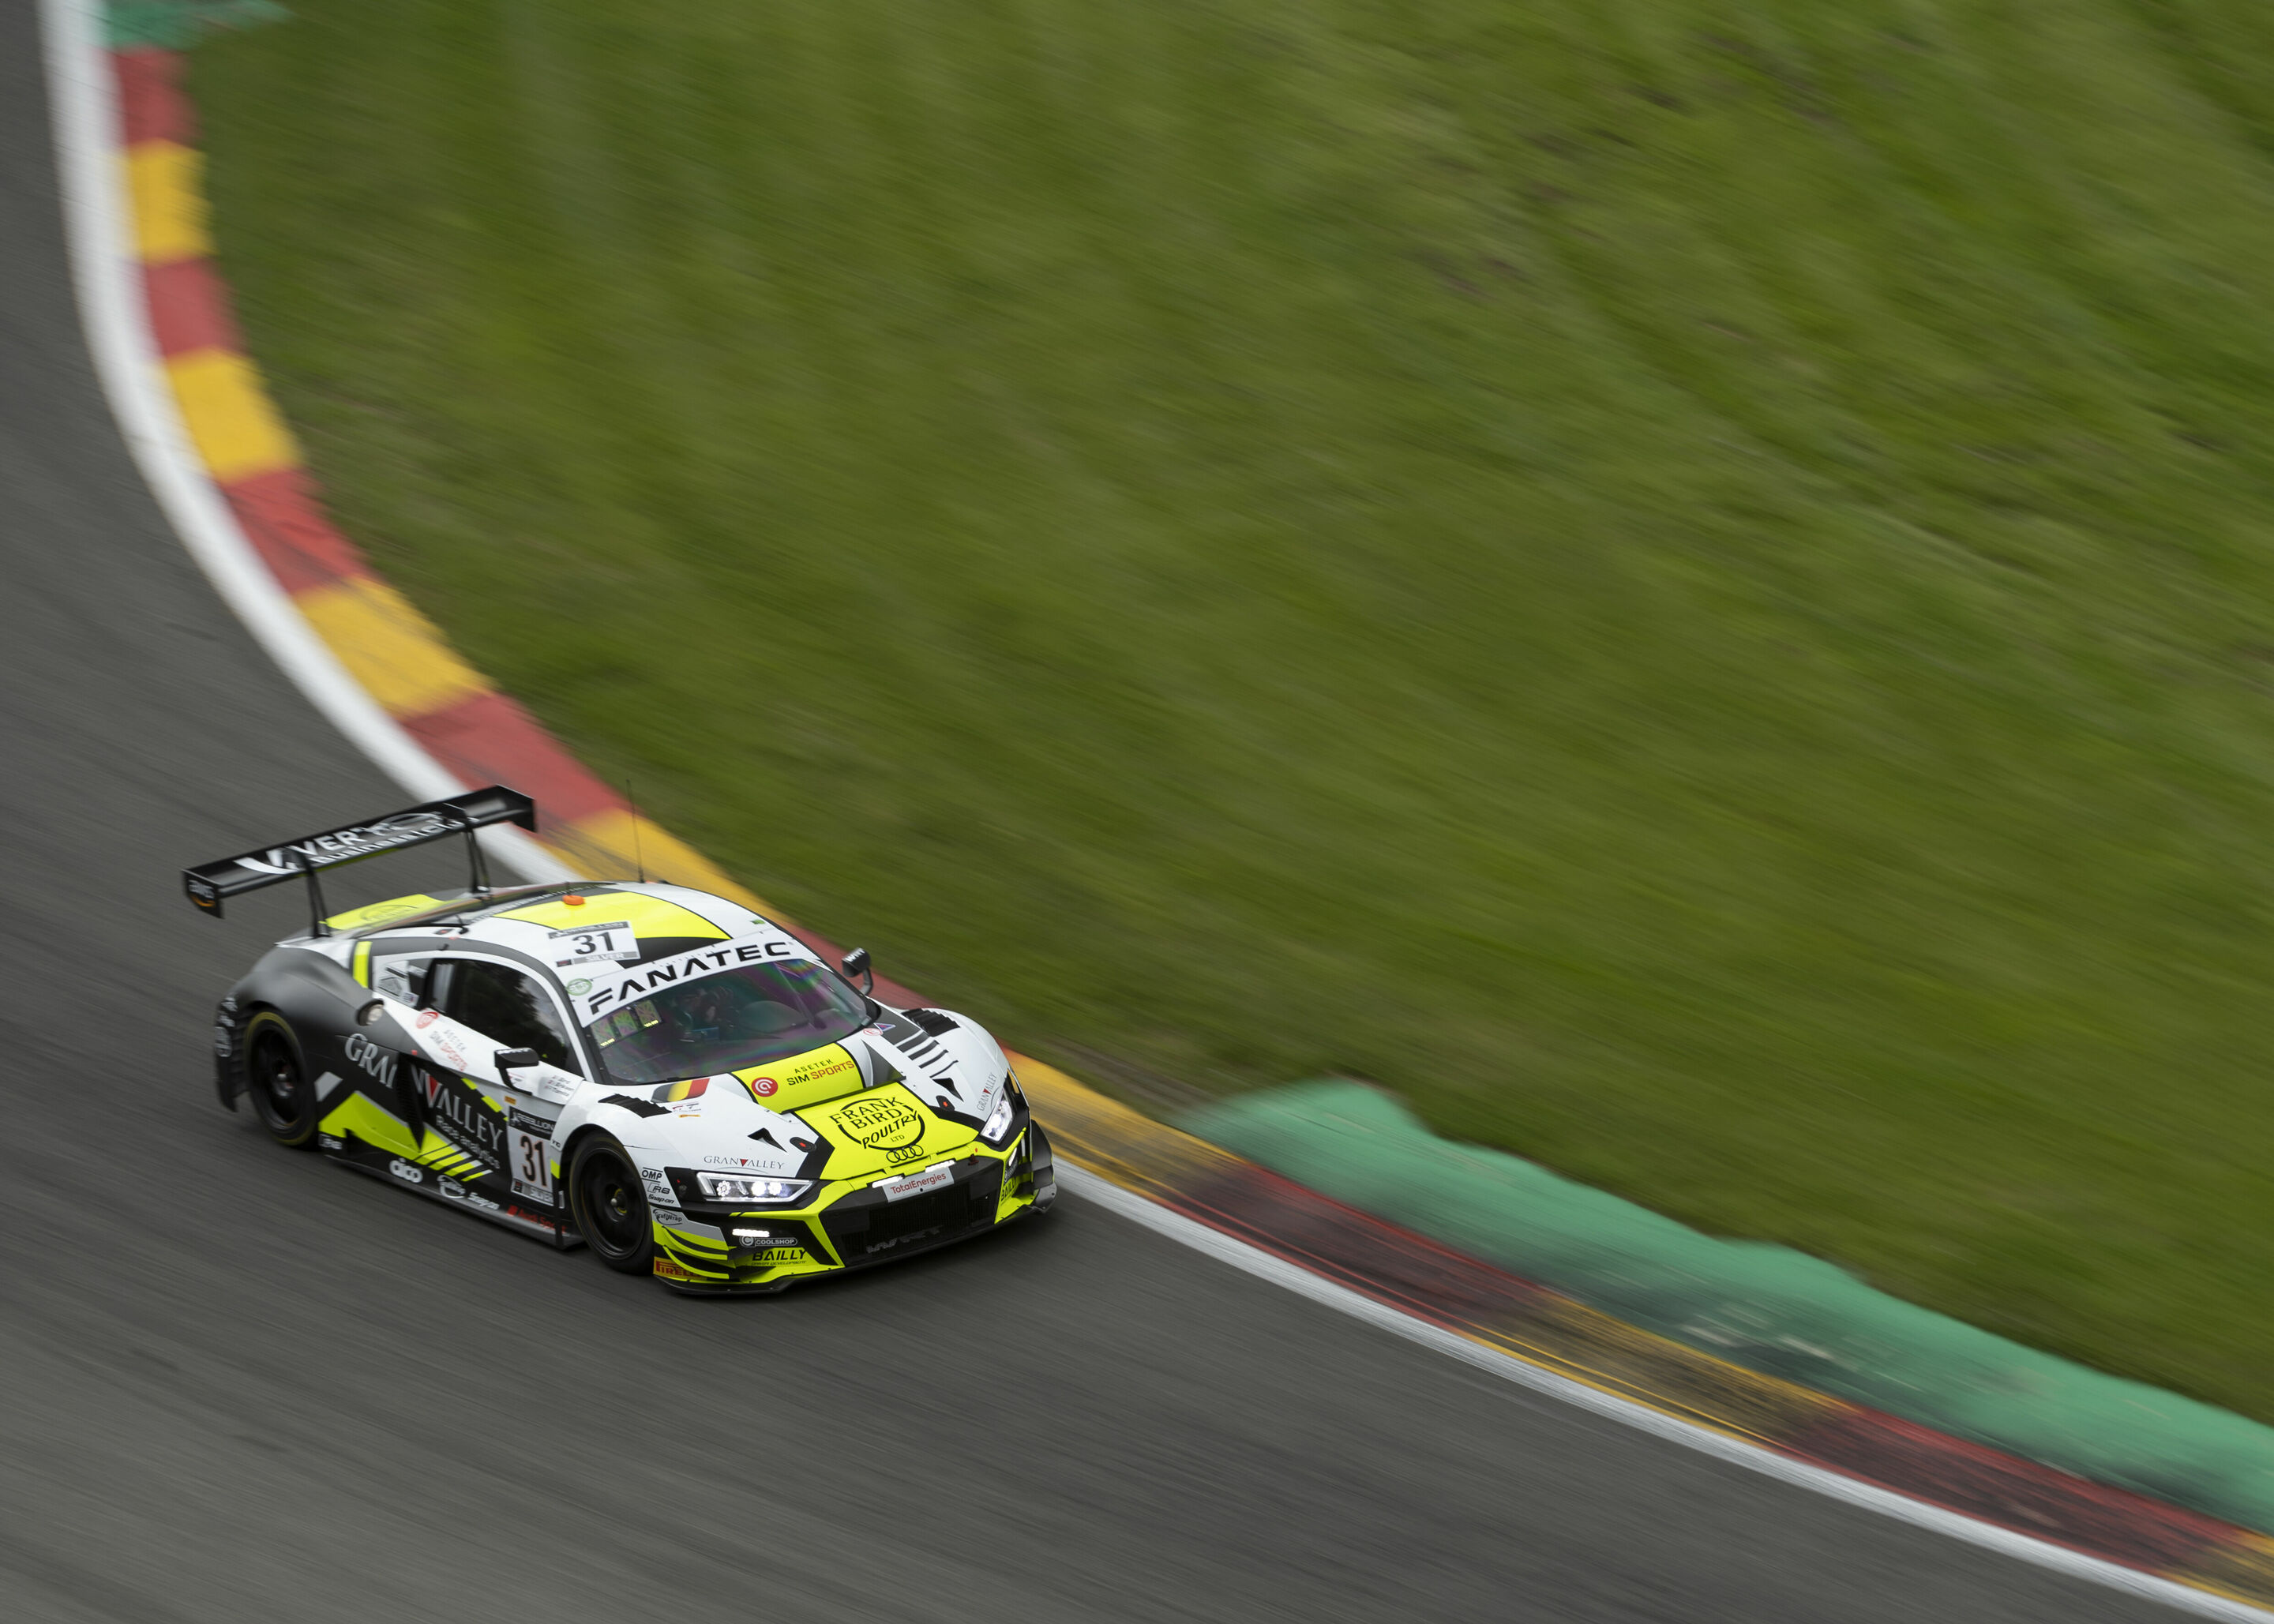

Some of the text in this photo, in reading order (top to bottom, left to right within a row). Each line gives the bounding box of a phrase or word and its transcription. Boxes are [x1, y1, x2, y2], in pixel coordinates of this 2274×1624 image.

[572, 932, 614, 955] 31
[588, 942, 790, 1015] FANATEC
[786, 1060, 854, 1086] SIM SPORTS
[794, 1059, 834, 1074] ASETEK
[828, 1097, 904, 1124] FRANK
[850, 1108, 902, 1130] BIRD
[861, 1110, 917, 1150] POULTRY
[520, 1135, 547, 1187] 31
[641, 1169, 662, 1180] OMP
[890, 1172, 947, 1195] TotalEnergies
[652, 1185, 671, 1195] R8
[539, 1216, 568, 1234] Spot
[752, 1249, 806, 1262] BAILLY
[655, 1260, 701, 1277] PIREL
